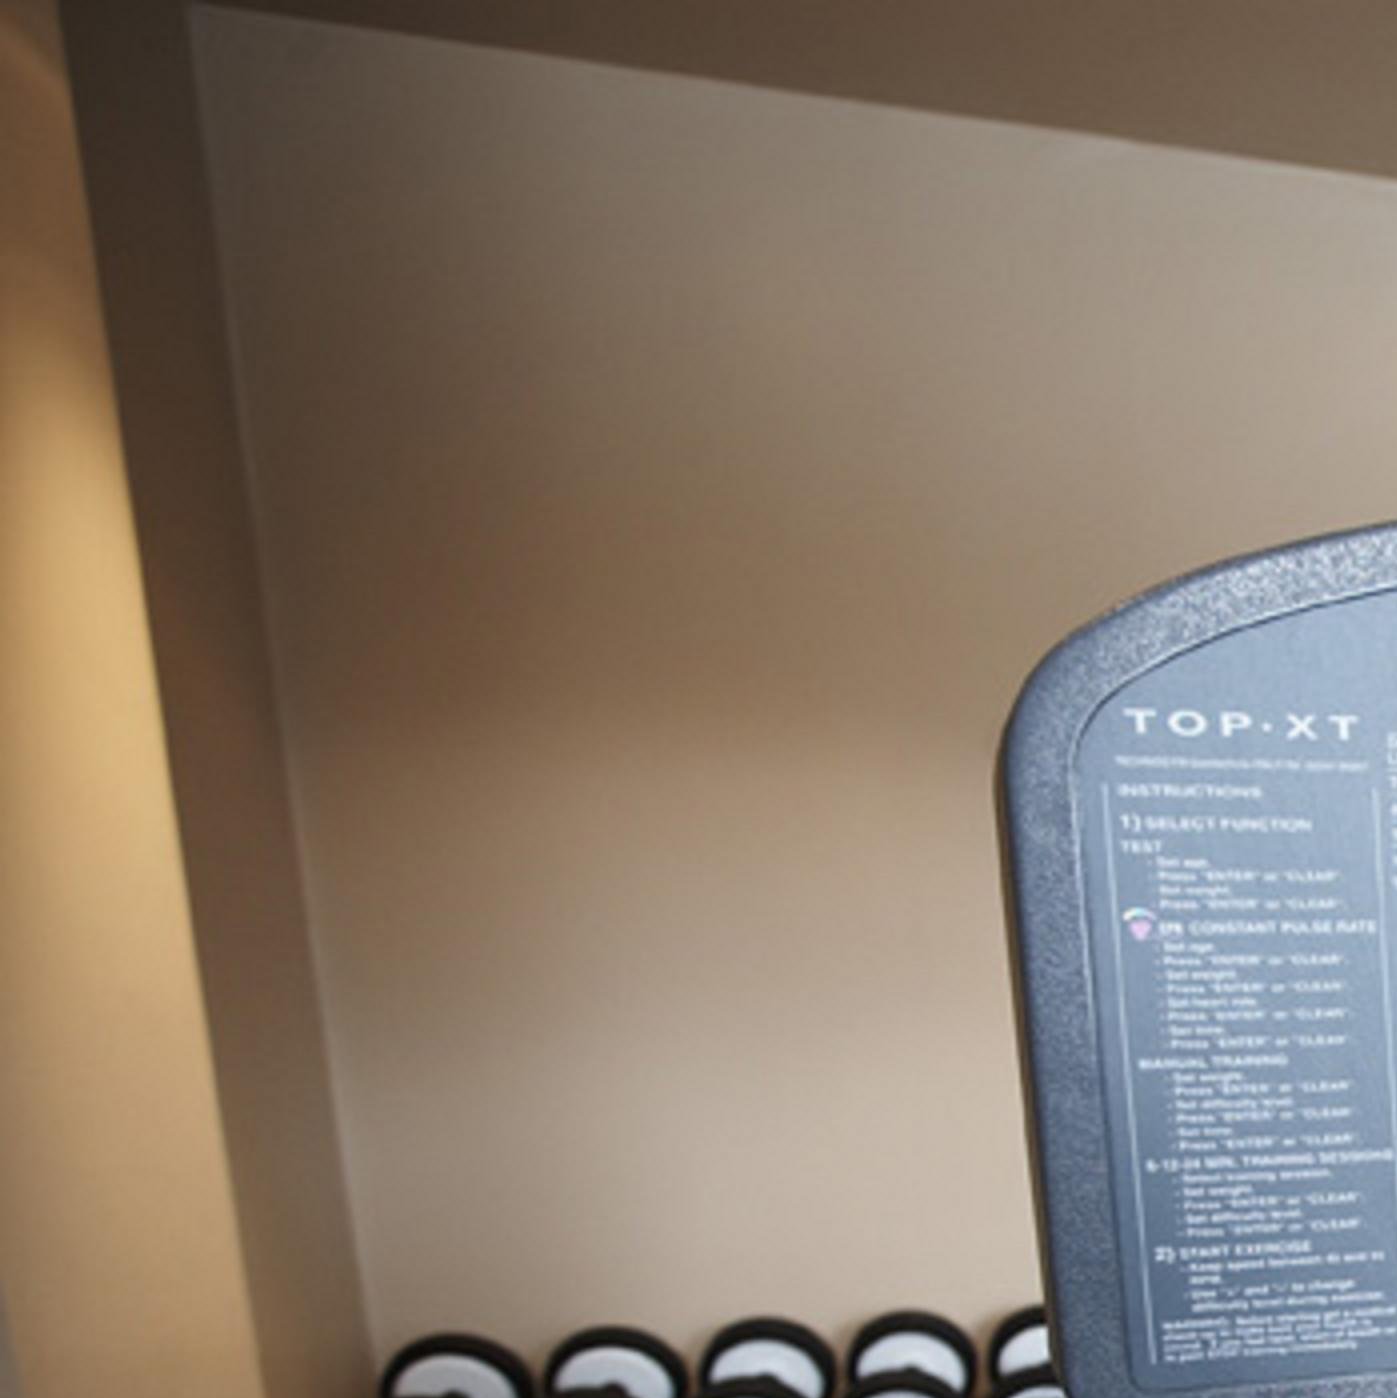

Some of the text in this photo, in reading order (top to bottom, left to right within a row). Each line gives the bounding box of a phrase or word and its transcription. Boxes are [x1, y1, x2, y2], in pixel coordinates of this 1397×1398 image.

[1118, 784, 1262, 799] INSTRUCTIONS
[1145, 816, 1217, 832] SELECT
[1220, 817, 1313, 833] FUNCTION
[1120, 840, 1162, 854] TEST
[1188, 920, 1276, 936] CONSTANT
[1281, 919, 1332, 935] PULSE
[1336, 919, 1377, 935] RATE
[1211, 1053, 1289, 1068] TRAINING
